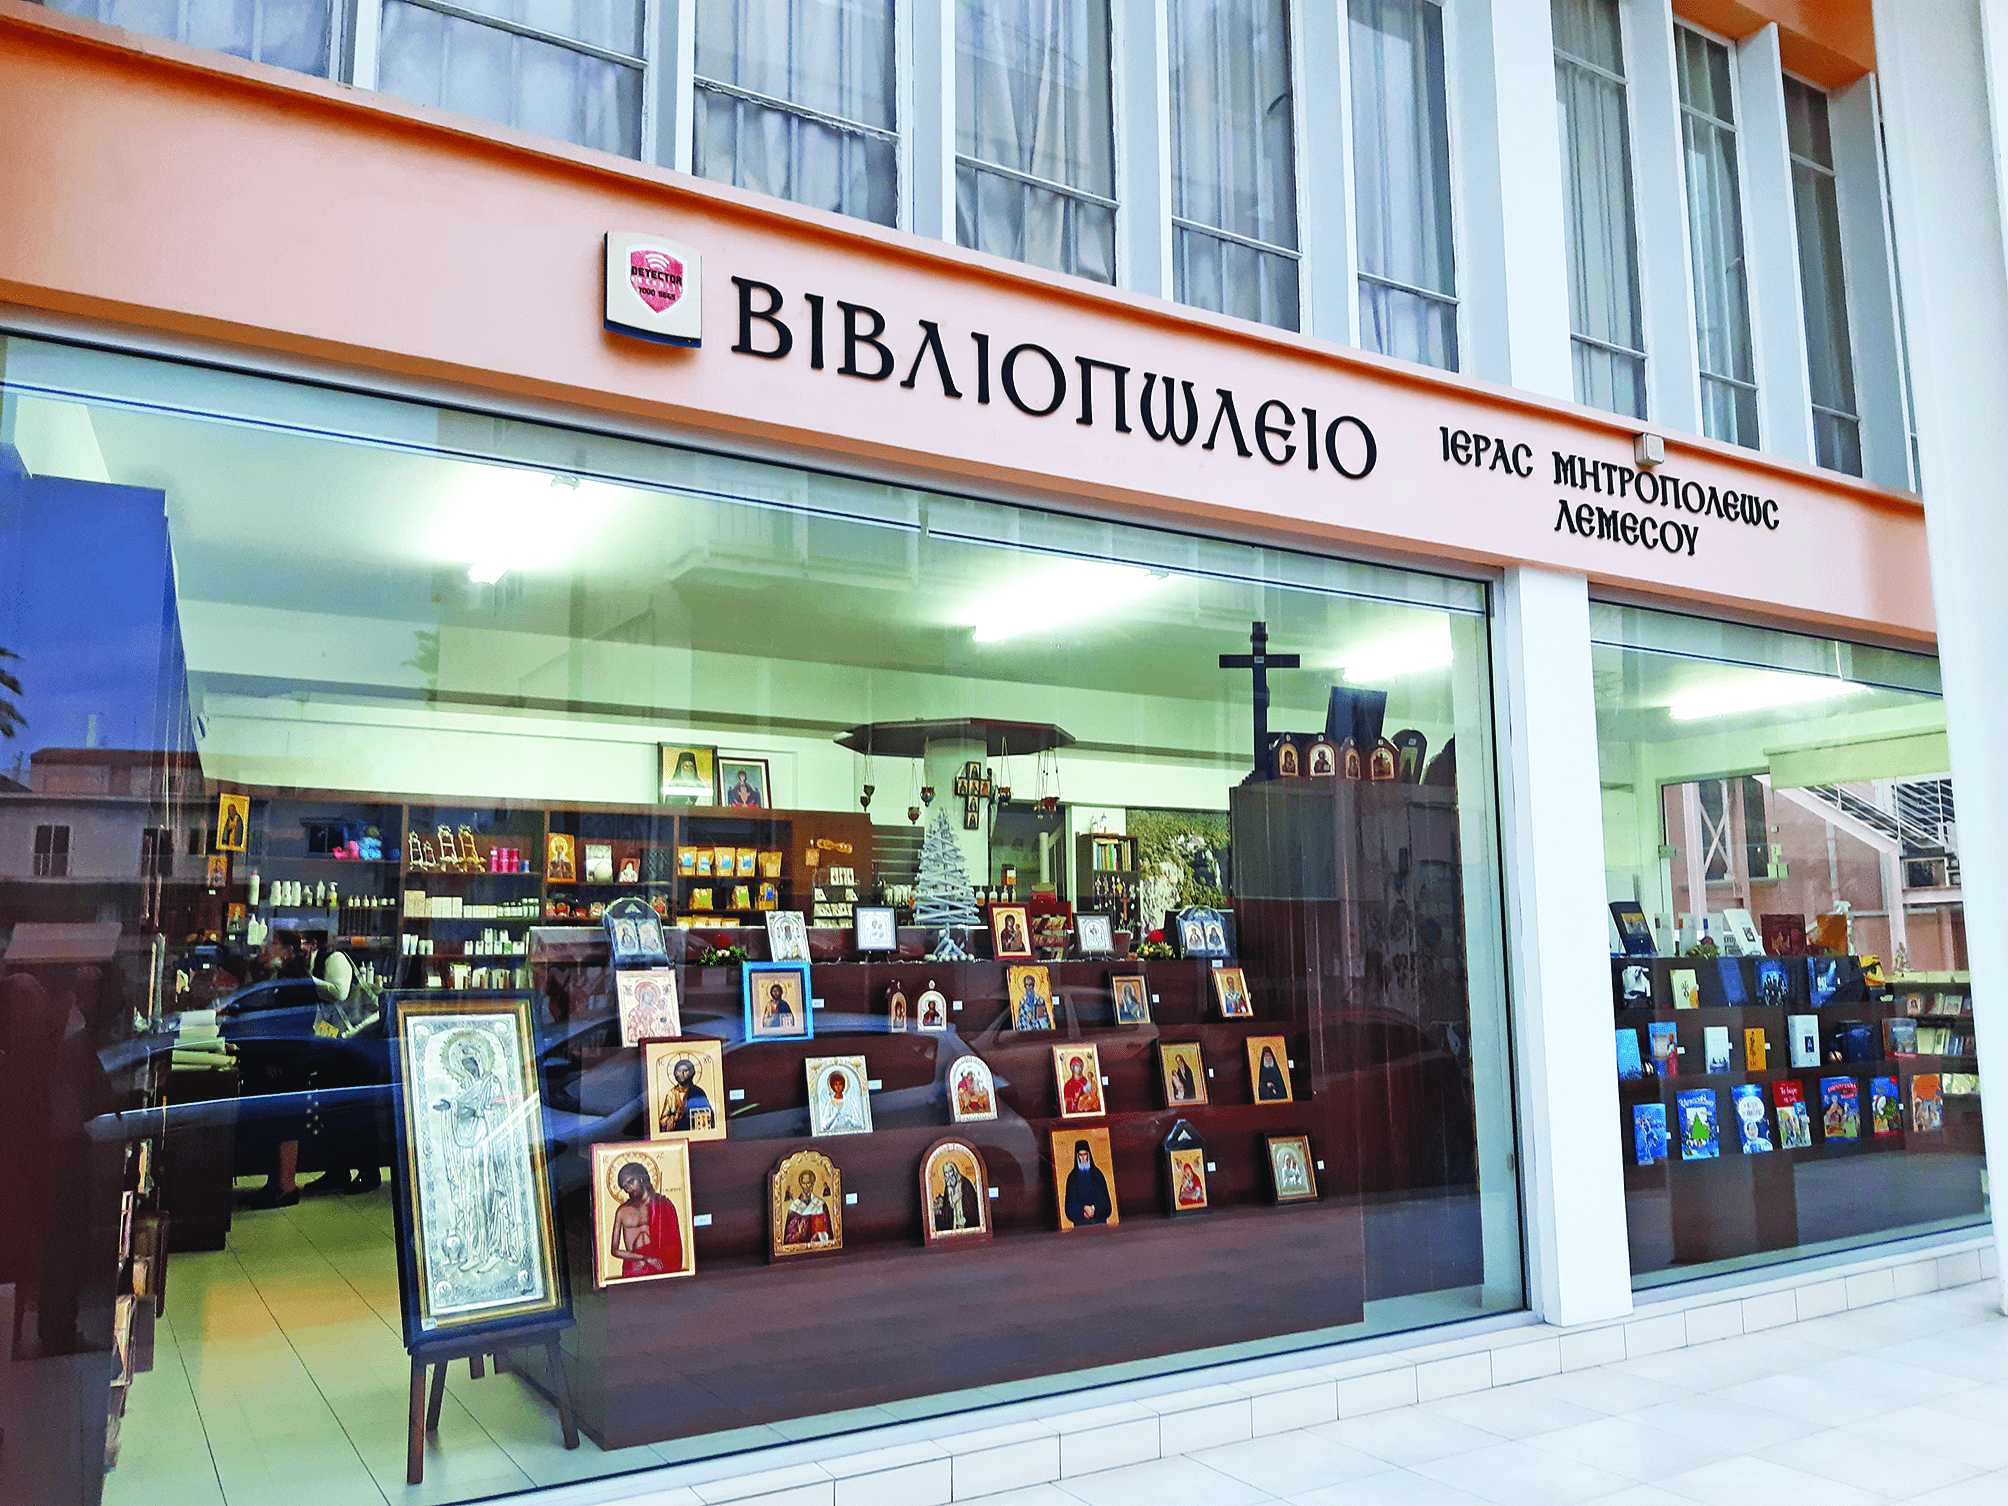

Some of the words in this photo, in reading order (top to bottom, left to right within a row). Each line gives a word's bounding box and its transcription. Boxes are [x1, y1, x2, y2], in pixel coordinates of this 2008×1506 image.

[631, 266, 683, 285] DETECTOR
[638, 286, 656, 296] 7000
[730, 275, 1378, 481] ΒΙΒΛΙΟΠΩΛΕΙΟ
